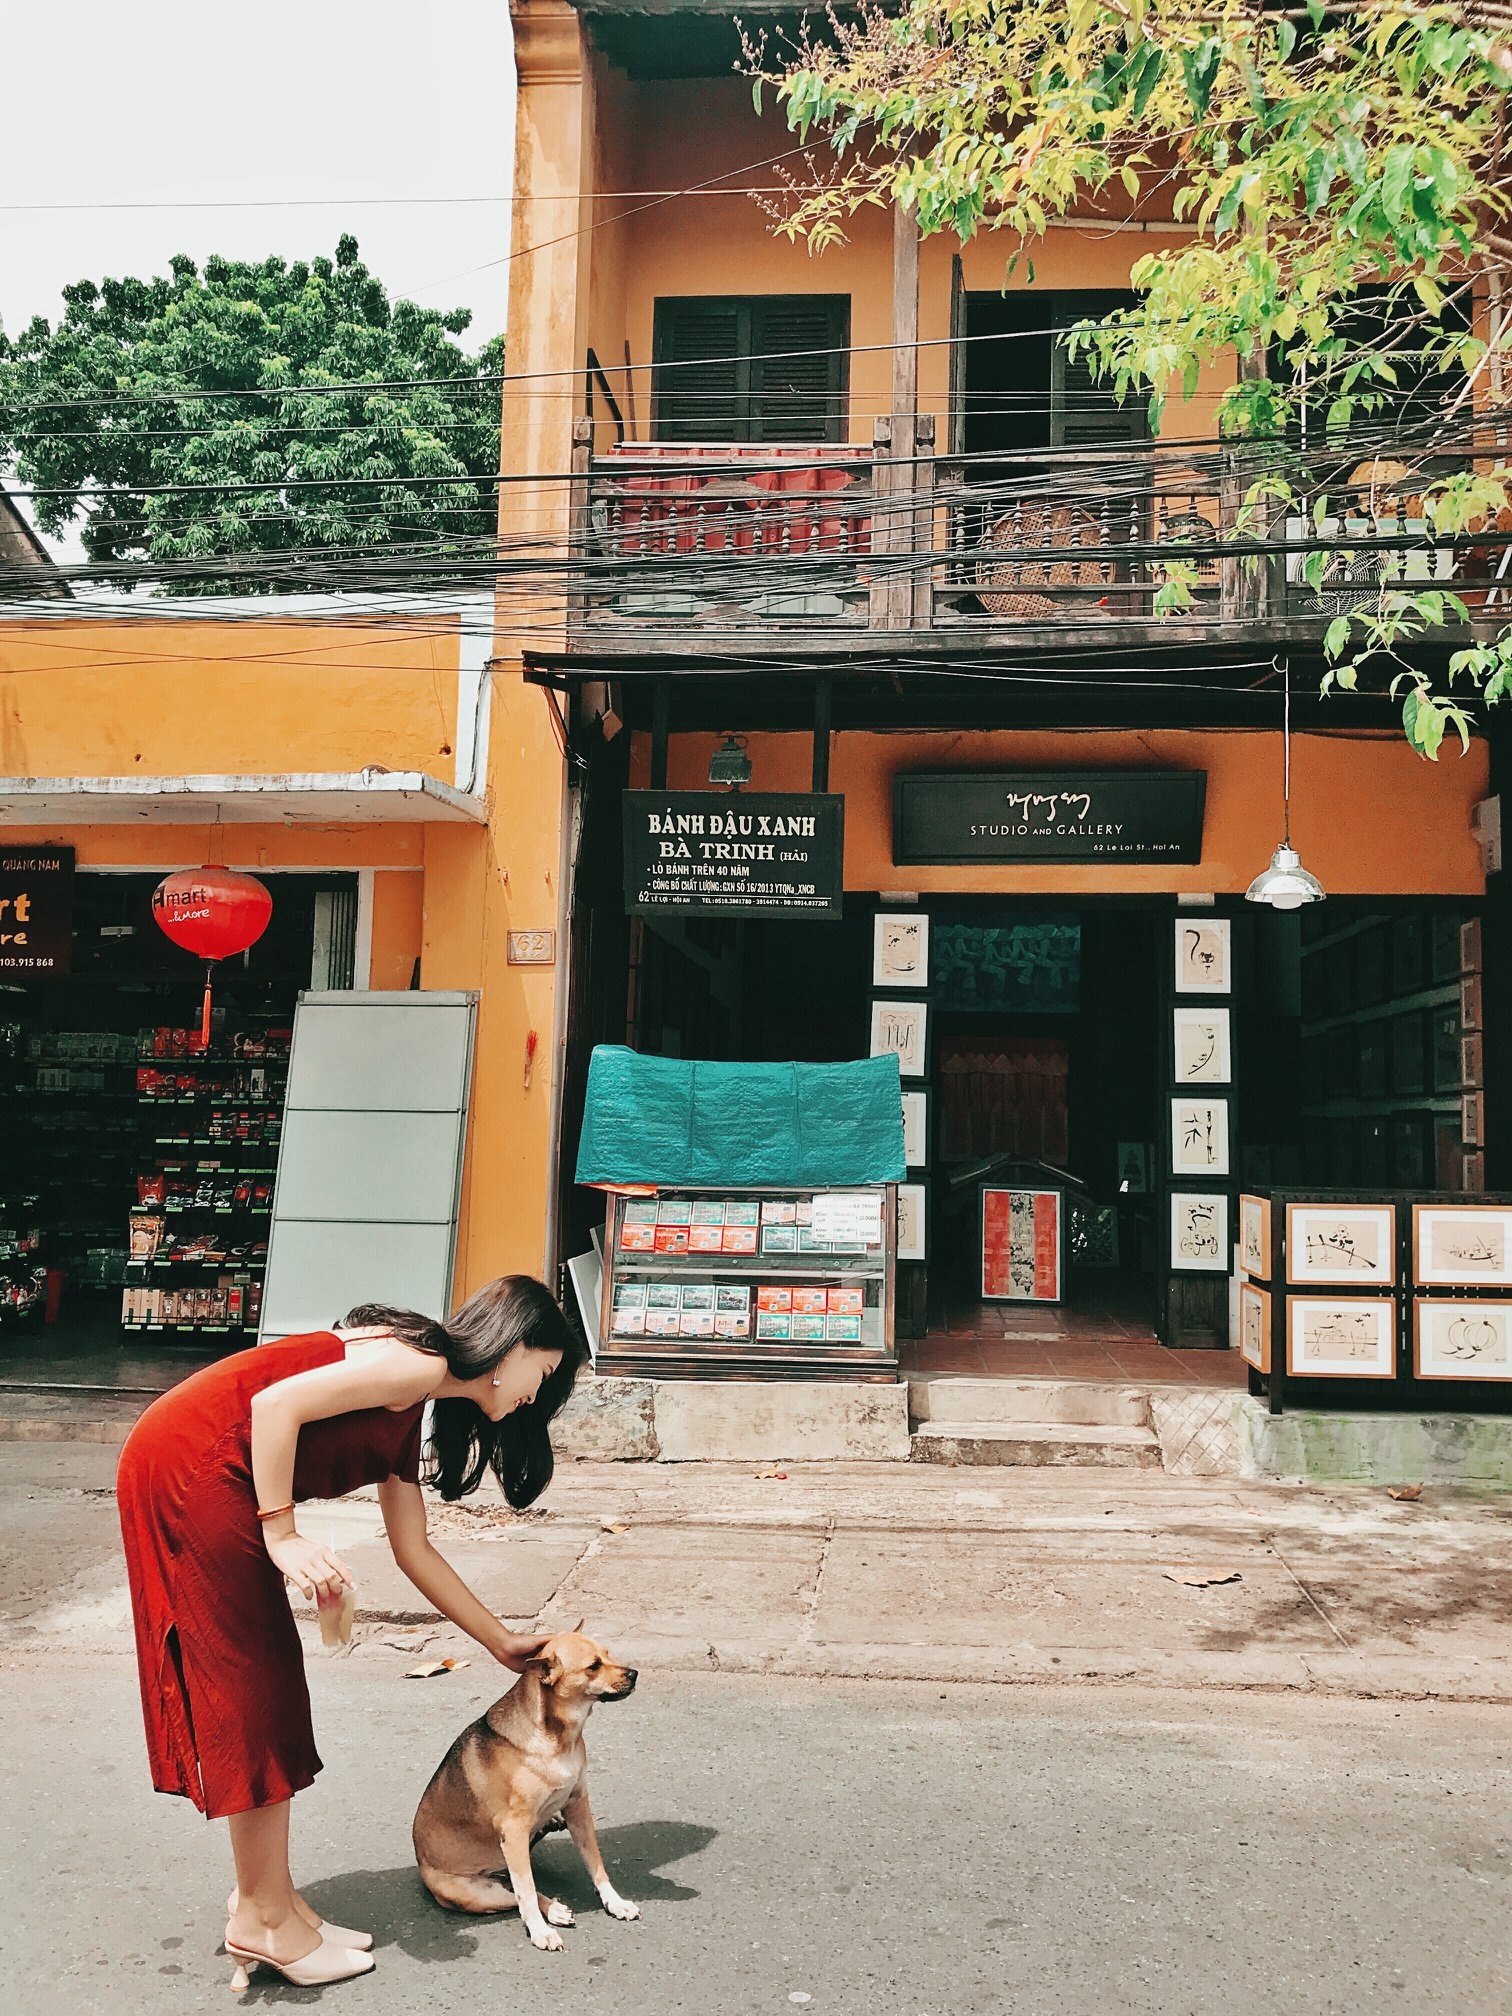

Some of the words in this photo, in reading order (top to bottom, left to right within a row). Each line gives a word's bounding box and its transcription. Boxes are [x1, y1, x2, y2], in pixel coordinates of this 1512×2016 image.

[648, 807, 704, 834] BÁNH
[709, 810, 753, 839] ĐẬU
[757, 816, 816, 836] XANH
[970, 825, 1028, 836] STUDIO
[1032, 828, 1052, 836] AND
[1056, 824, 1123, 836] GALLERY
[659, 837, 692, 859] BÀ
[699, 842, 775, 861] TRINH
[38, 860, 60, 871] NAM
[652, 861, 664, 875] LÒ
[665, 862, 690, 875] BÁNH
[691, 863, 715, 876] TRÊN
[716, 866, 728, 876] 40
[652, 878, 670, 890] CÔNG
[670, 877, 680, 890] BỐ
[681, 877, 697, 890] CHẤT
[736, 879, 745, 892] SỐ
[746, 883, 774, 893] 16/2013
[638, 891, 650, 902] 62
[517, 934, 544, 951] 62
[36, 958, 54, 967] 868
